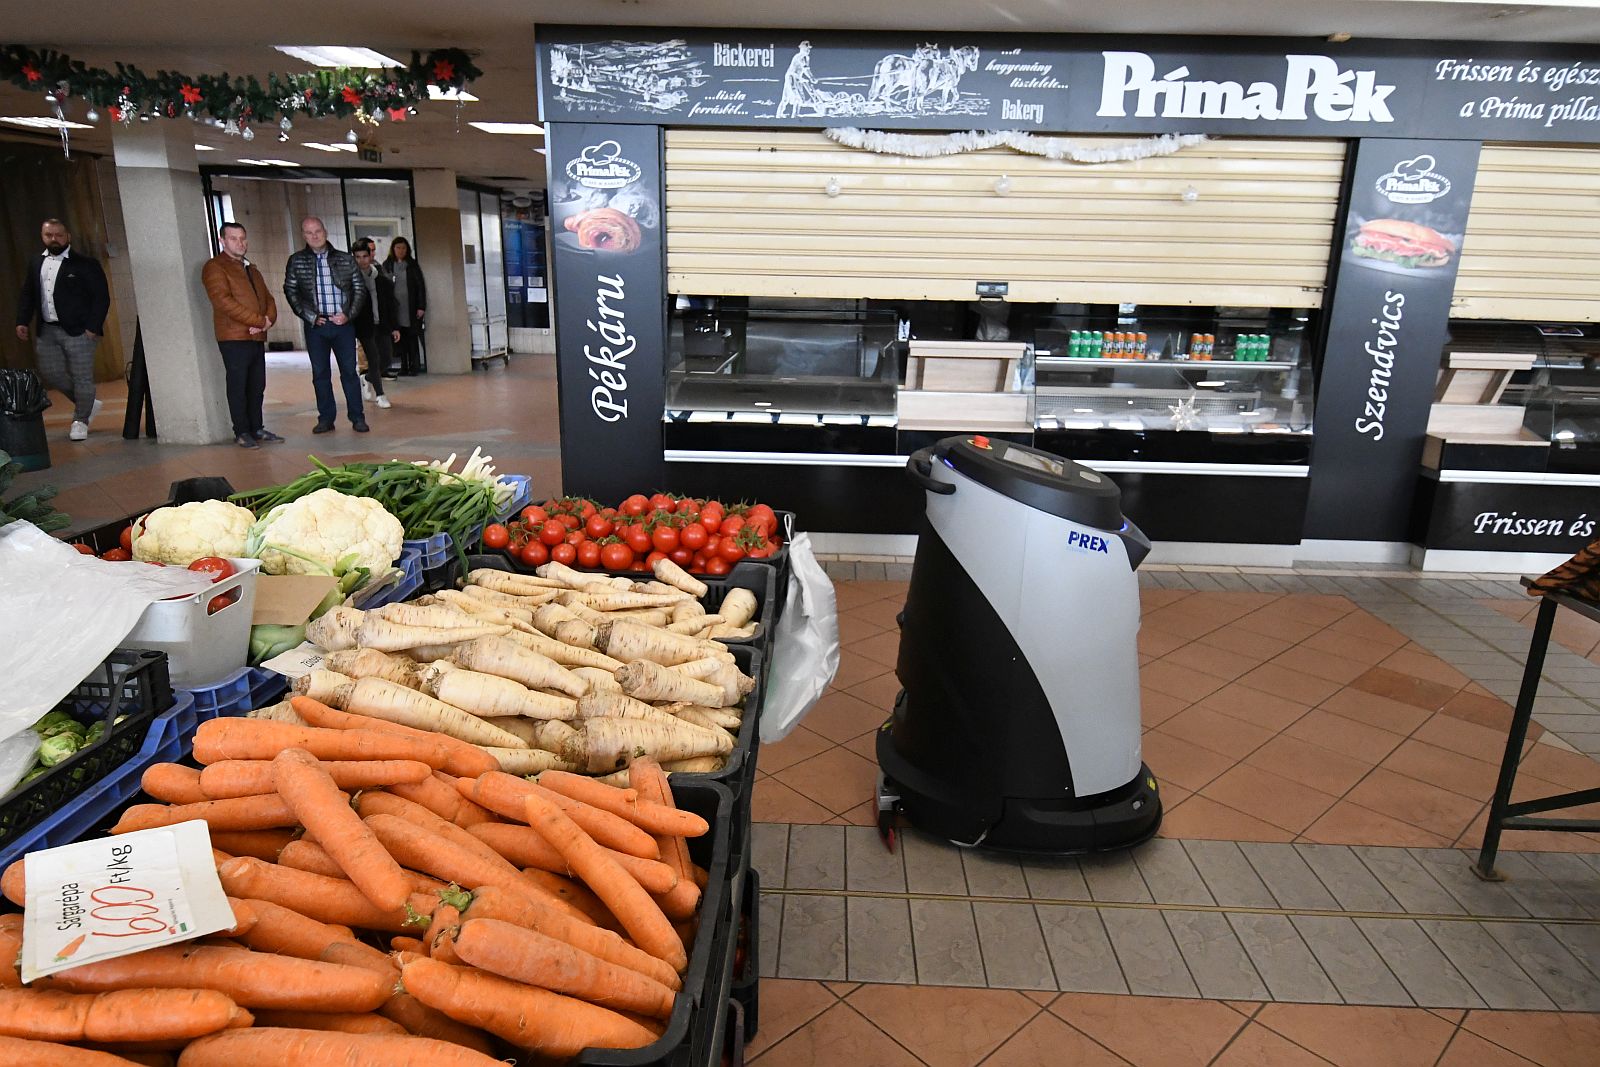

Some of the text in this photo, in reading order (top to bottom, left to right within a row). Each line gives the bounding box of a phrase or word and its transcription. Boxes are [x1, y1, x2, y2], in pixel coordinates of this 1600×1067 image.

[713, 42, 775, 68] Bäckerei
[985, 58, 1053, 76] hagyomány
[1096, 50, 1397, 123] PrímaPék
[1435, 58, 1600, 92] Frissen és egész
[1001, 98, 1044, 124] Bakery
[1459, 101, 1475, 118] a
[1480, 96, 1546, 119] Príma
[584, 274, 637, 422] Pékáru
[1355, 290, 1405, 441] Szendvics
[1473, 511, 1596, 537] Frissen és
[1068, 530, 1110, 554] PREX
[91, 844, 167, 937] 600 Ft/kg
[56, 882, 86, 931] Sárgarépa
